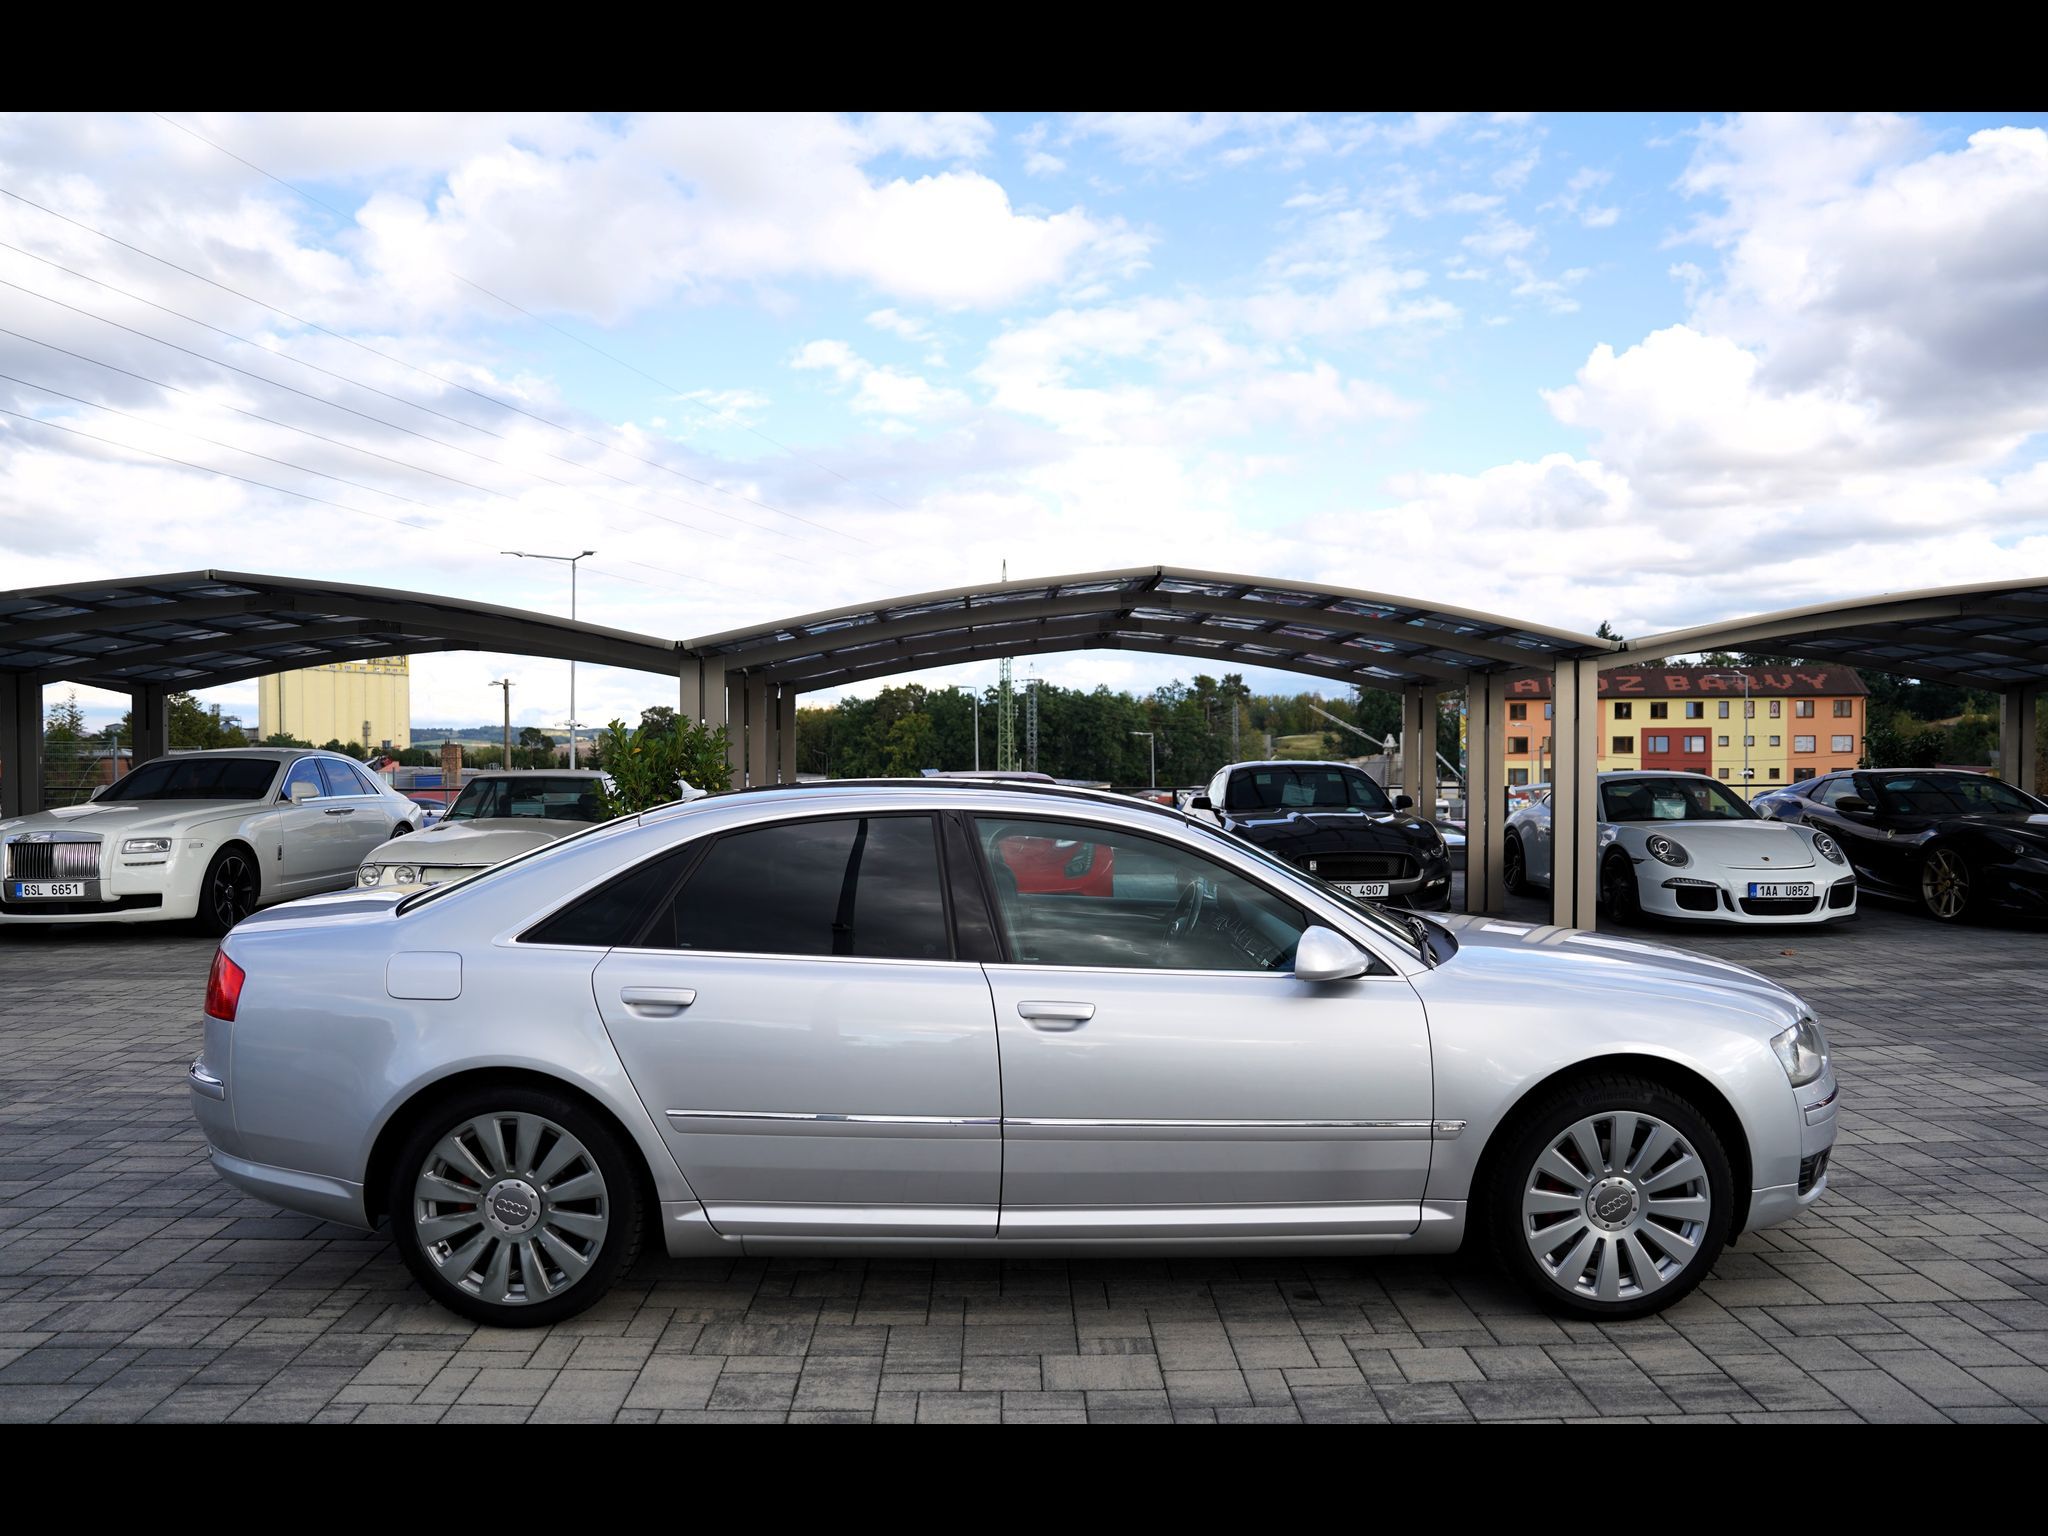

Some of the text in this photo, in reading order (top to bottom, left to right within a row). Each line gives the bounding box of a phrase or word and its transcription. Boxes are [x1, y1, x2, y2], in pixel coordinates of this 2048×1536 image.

[24, 884, 43, 896] 6SL
[51, 884, 78, 895] 6651
[1360, 885, 1385, 896] 4907
[1760, 885, 1778, 896] 1AA
[1785, 885, 1810, 896] U852
